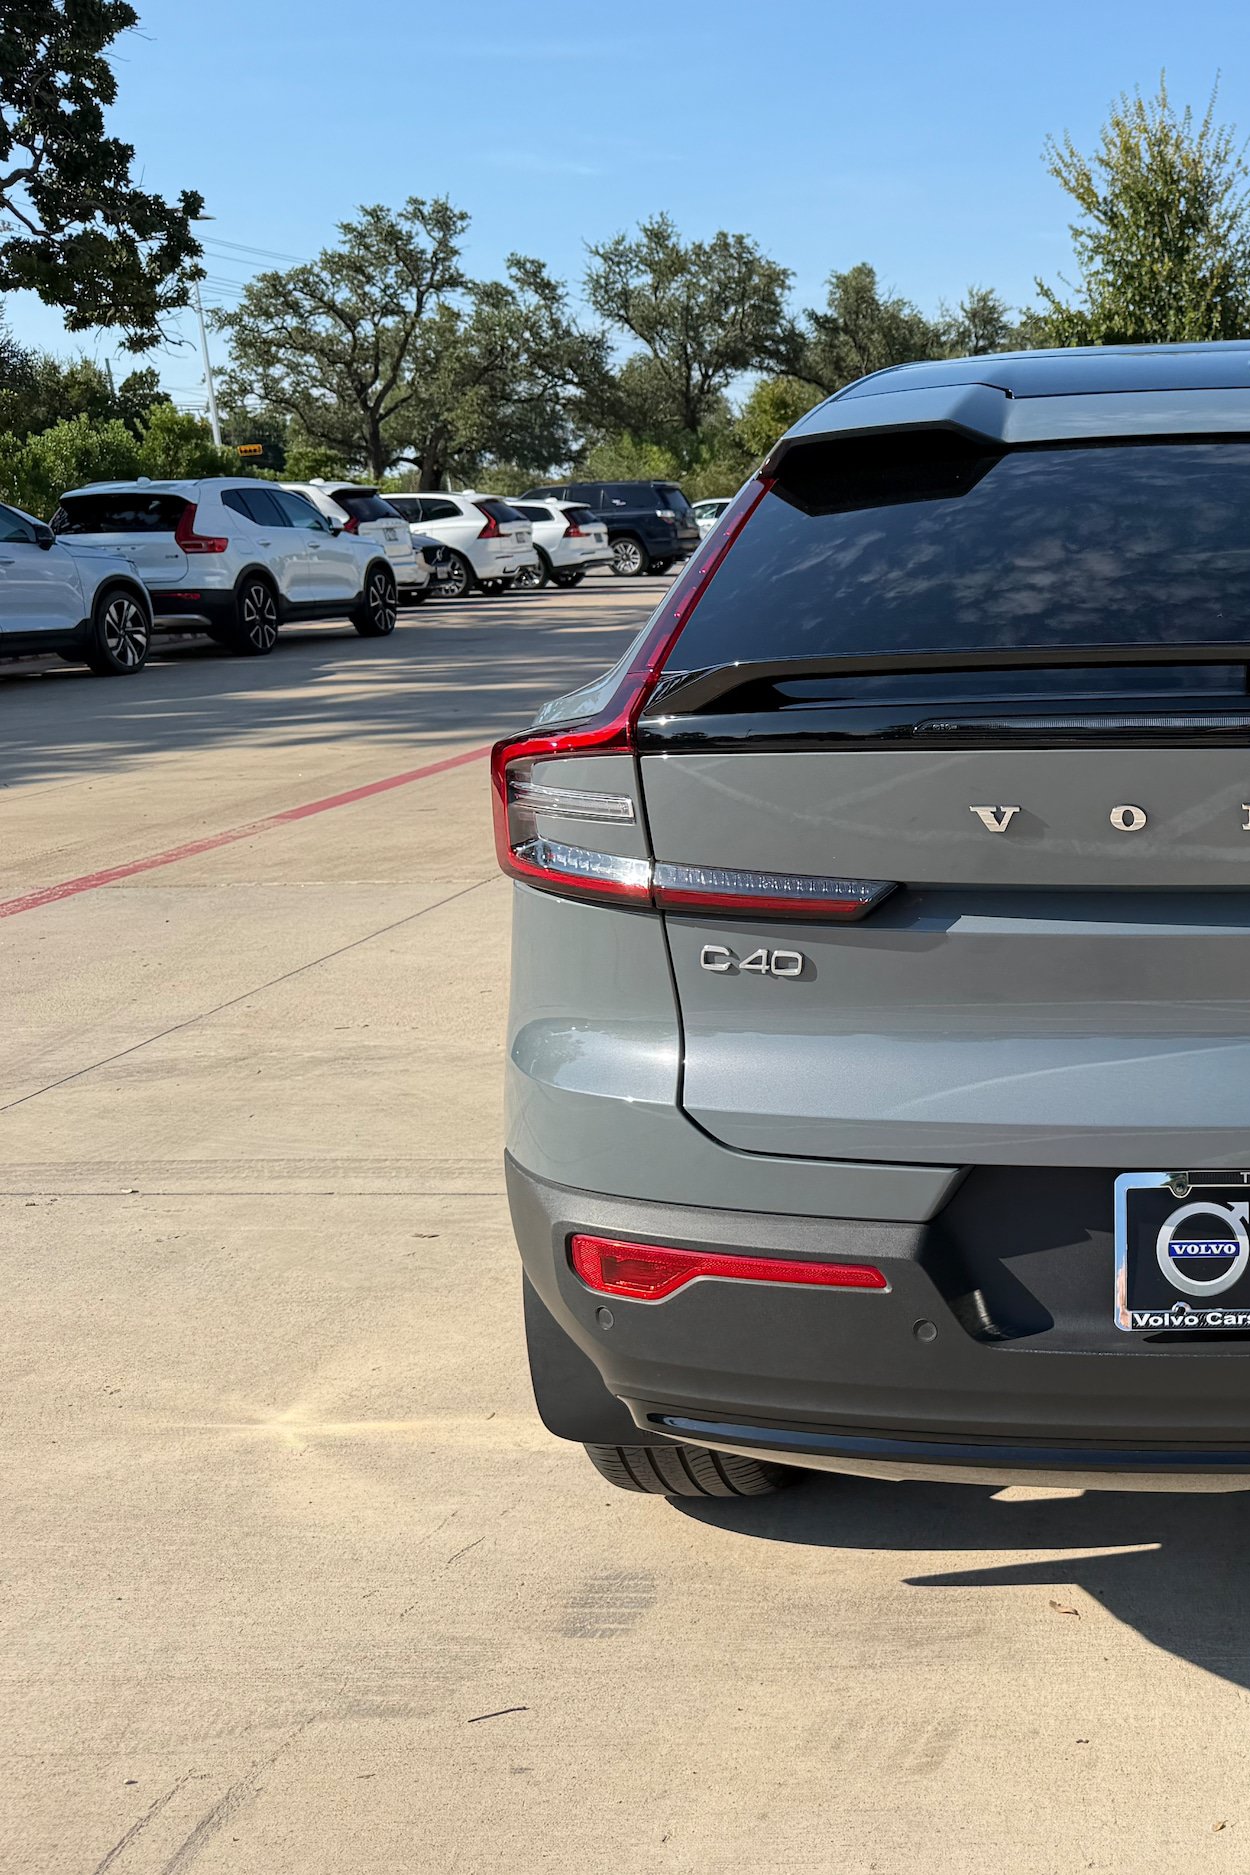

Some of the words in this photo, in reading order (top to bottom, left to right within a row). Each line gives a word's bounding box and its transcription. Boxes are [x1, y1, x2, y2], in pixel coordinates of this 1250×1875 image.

[700, 944, 803, 977] C40
[1171, 1242, 1237, 1256] VOLVO
[1132, 1312, 1199, 1326] Volvo
